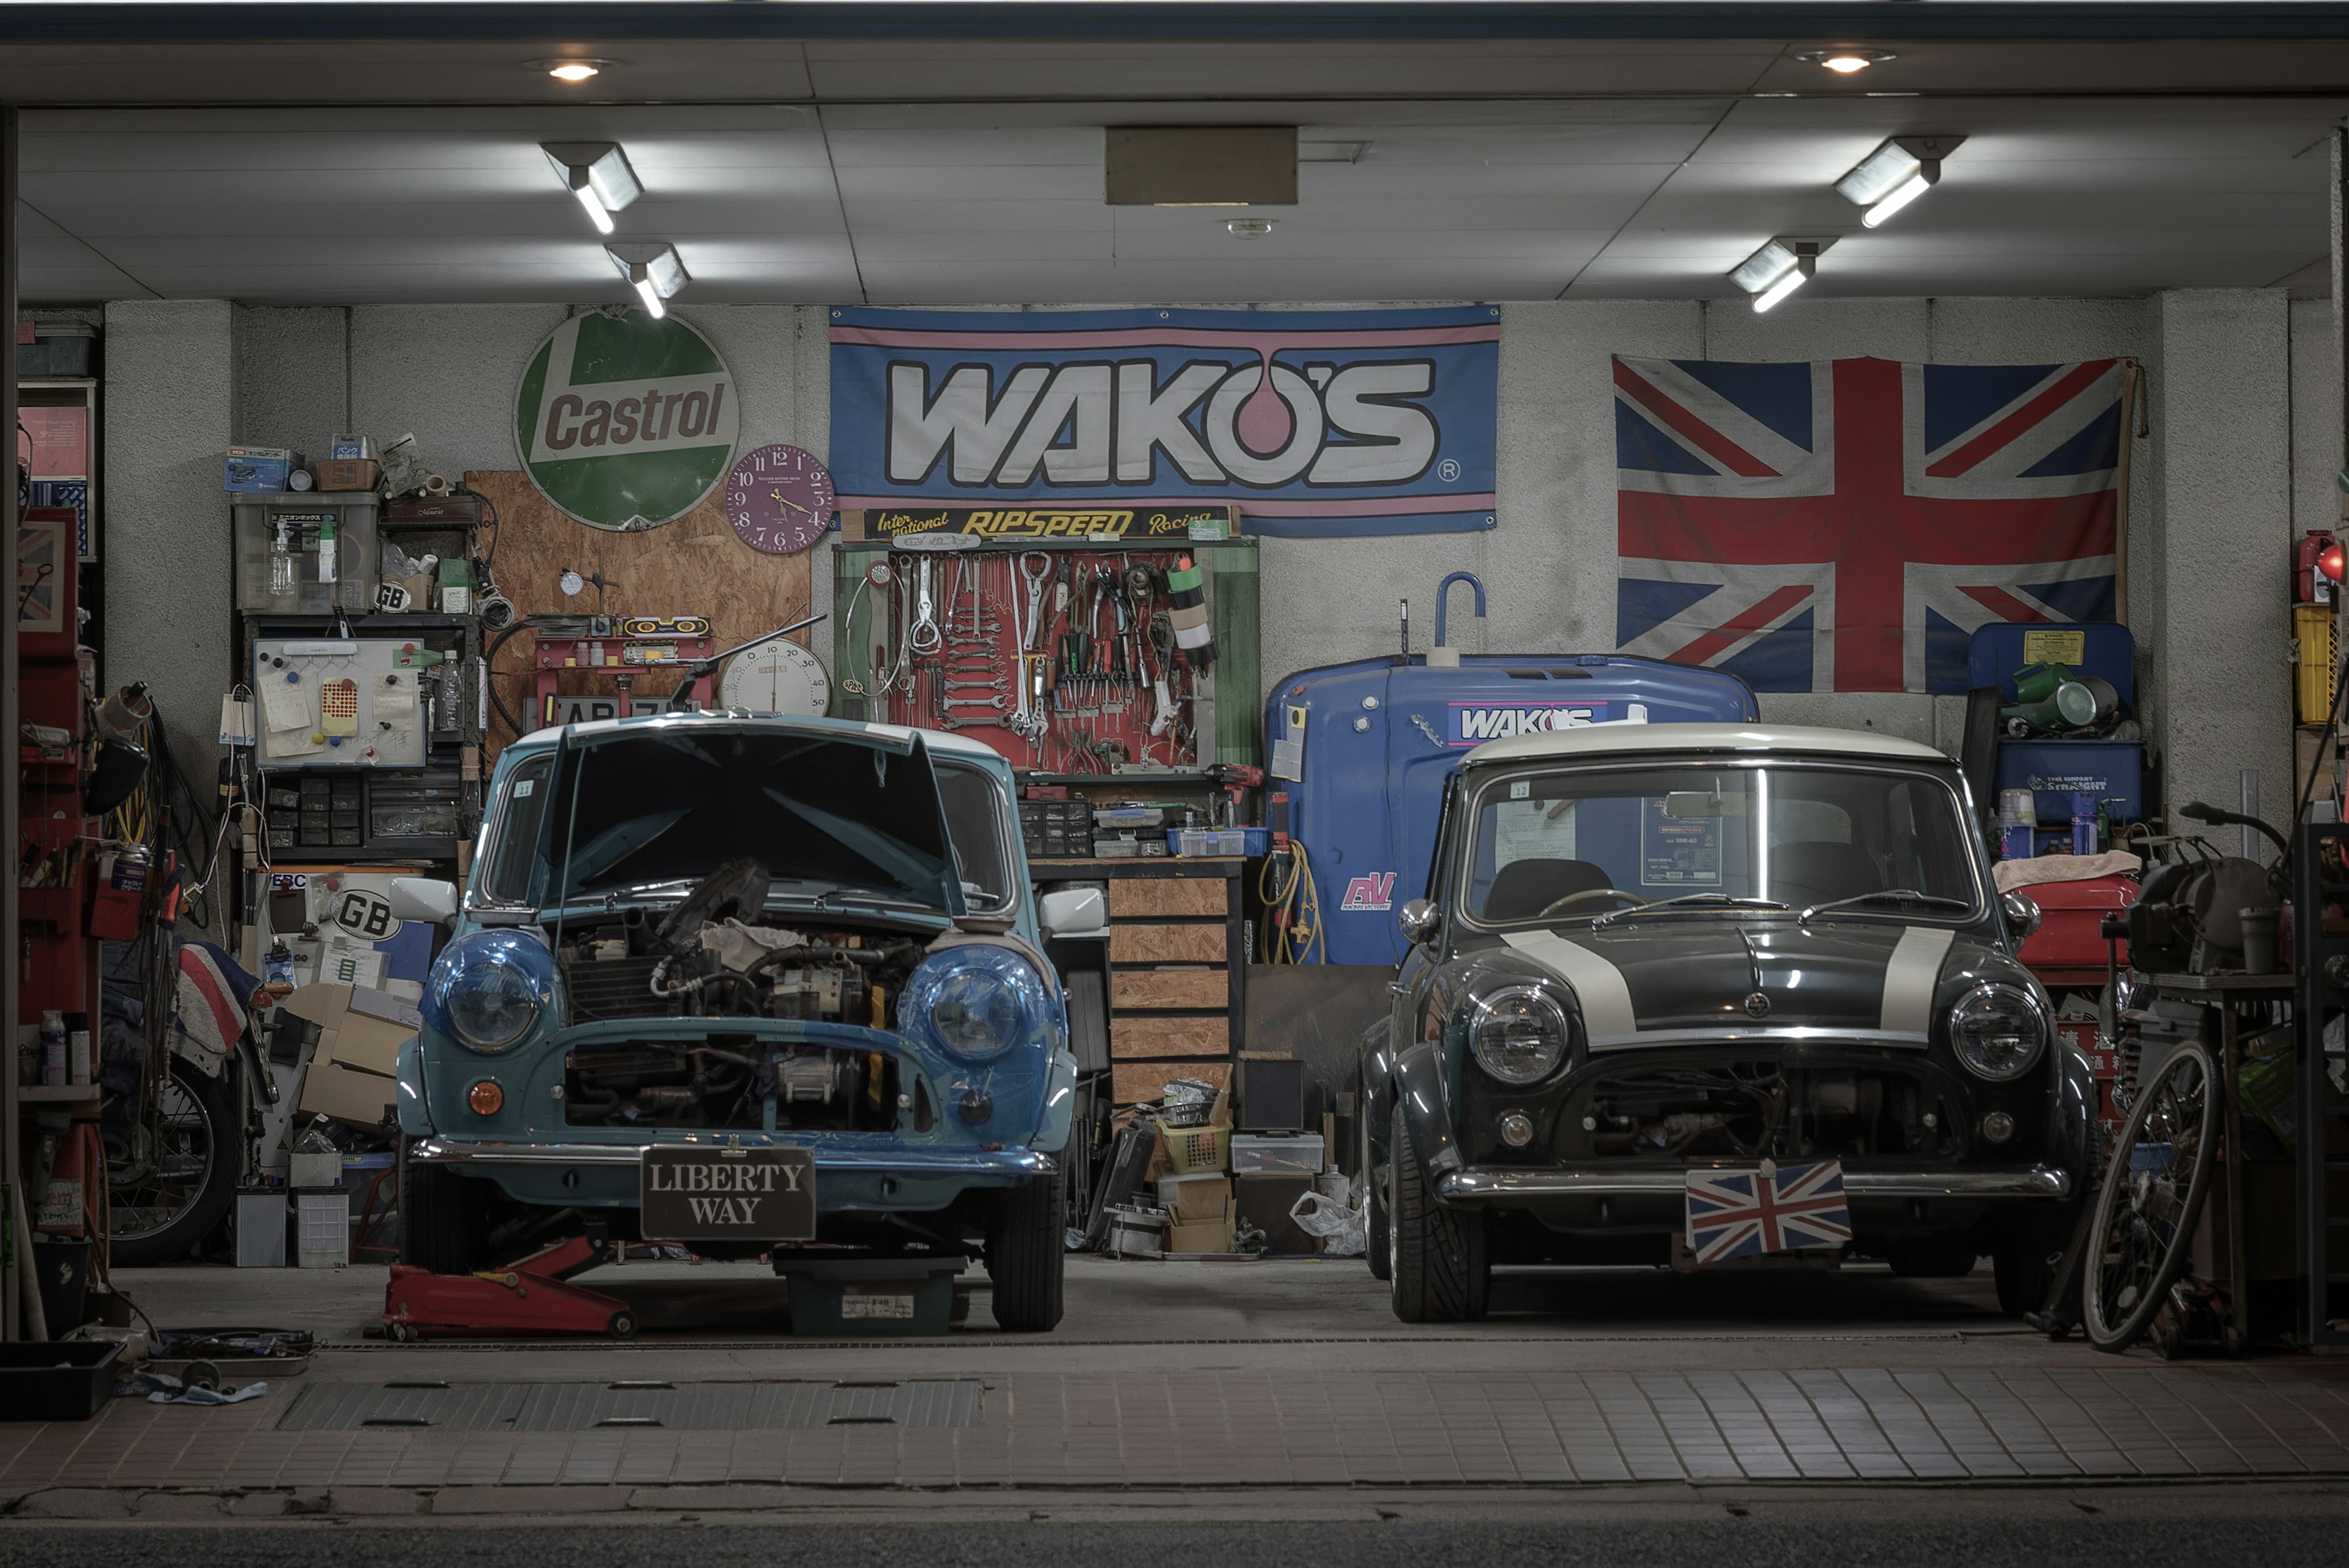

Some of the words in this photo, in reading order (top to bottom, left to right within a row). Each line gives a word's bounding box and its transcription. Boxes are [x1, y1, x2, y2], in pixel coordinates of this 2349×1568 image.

[544, 383, 725, 450] Castrol
[886, 359, 1438, 487] WAKO'S
[755, 457, 765, 471] 11
[773, 451, 788, 466] 12
[797, 456, 801, 470] 1
[740, 472, 754, 487] 10
[810, 472, 822, 487] 2
[734, 491, 747, 507] 9
[813, 491, 825, 507] 3
[739, 511, 751, 527] 8
[808, 511, 820, 526] 4
[877, 512, 911, 531] Inter
[892, 511, 949, 537] national
[961, 510, 1134, 537] RIPSPEED
[756, 527, 767, 541] 7
[774, 532, 785, 546] 6
[793, 527, 805, 541] 5
[376, 585, 404, 609] GB
[1517, 787, 1527, 795] 12
[273, 874, 306, 887] EBC
[1343, 873, 1395, 904] RV
[339, 894, 391, 936] GB
[648, 1164, 805, 1192] LIBERTY
[688, 1197, 762, 1225] WAY
